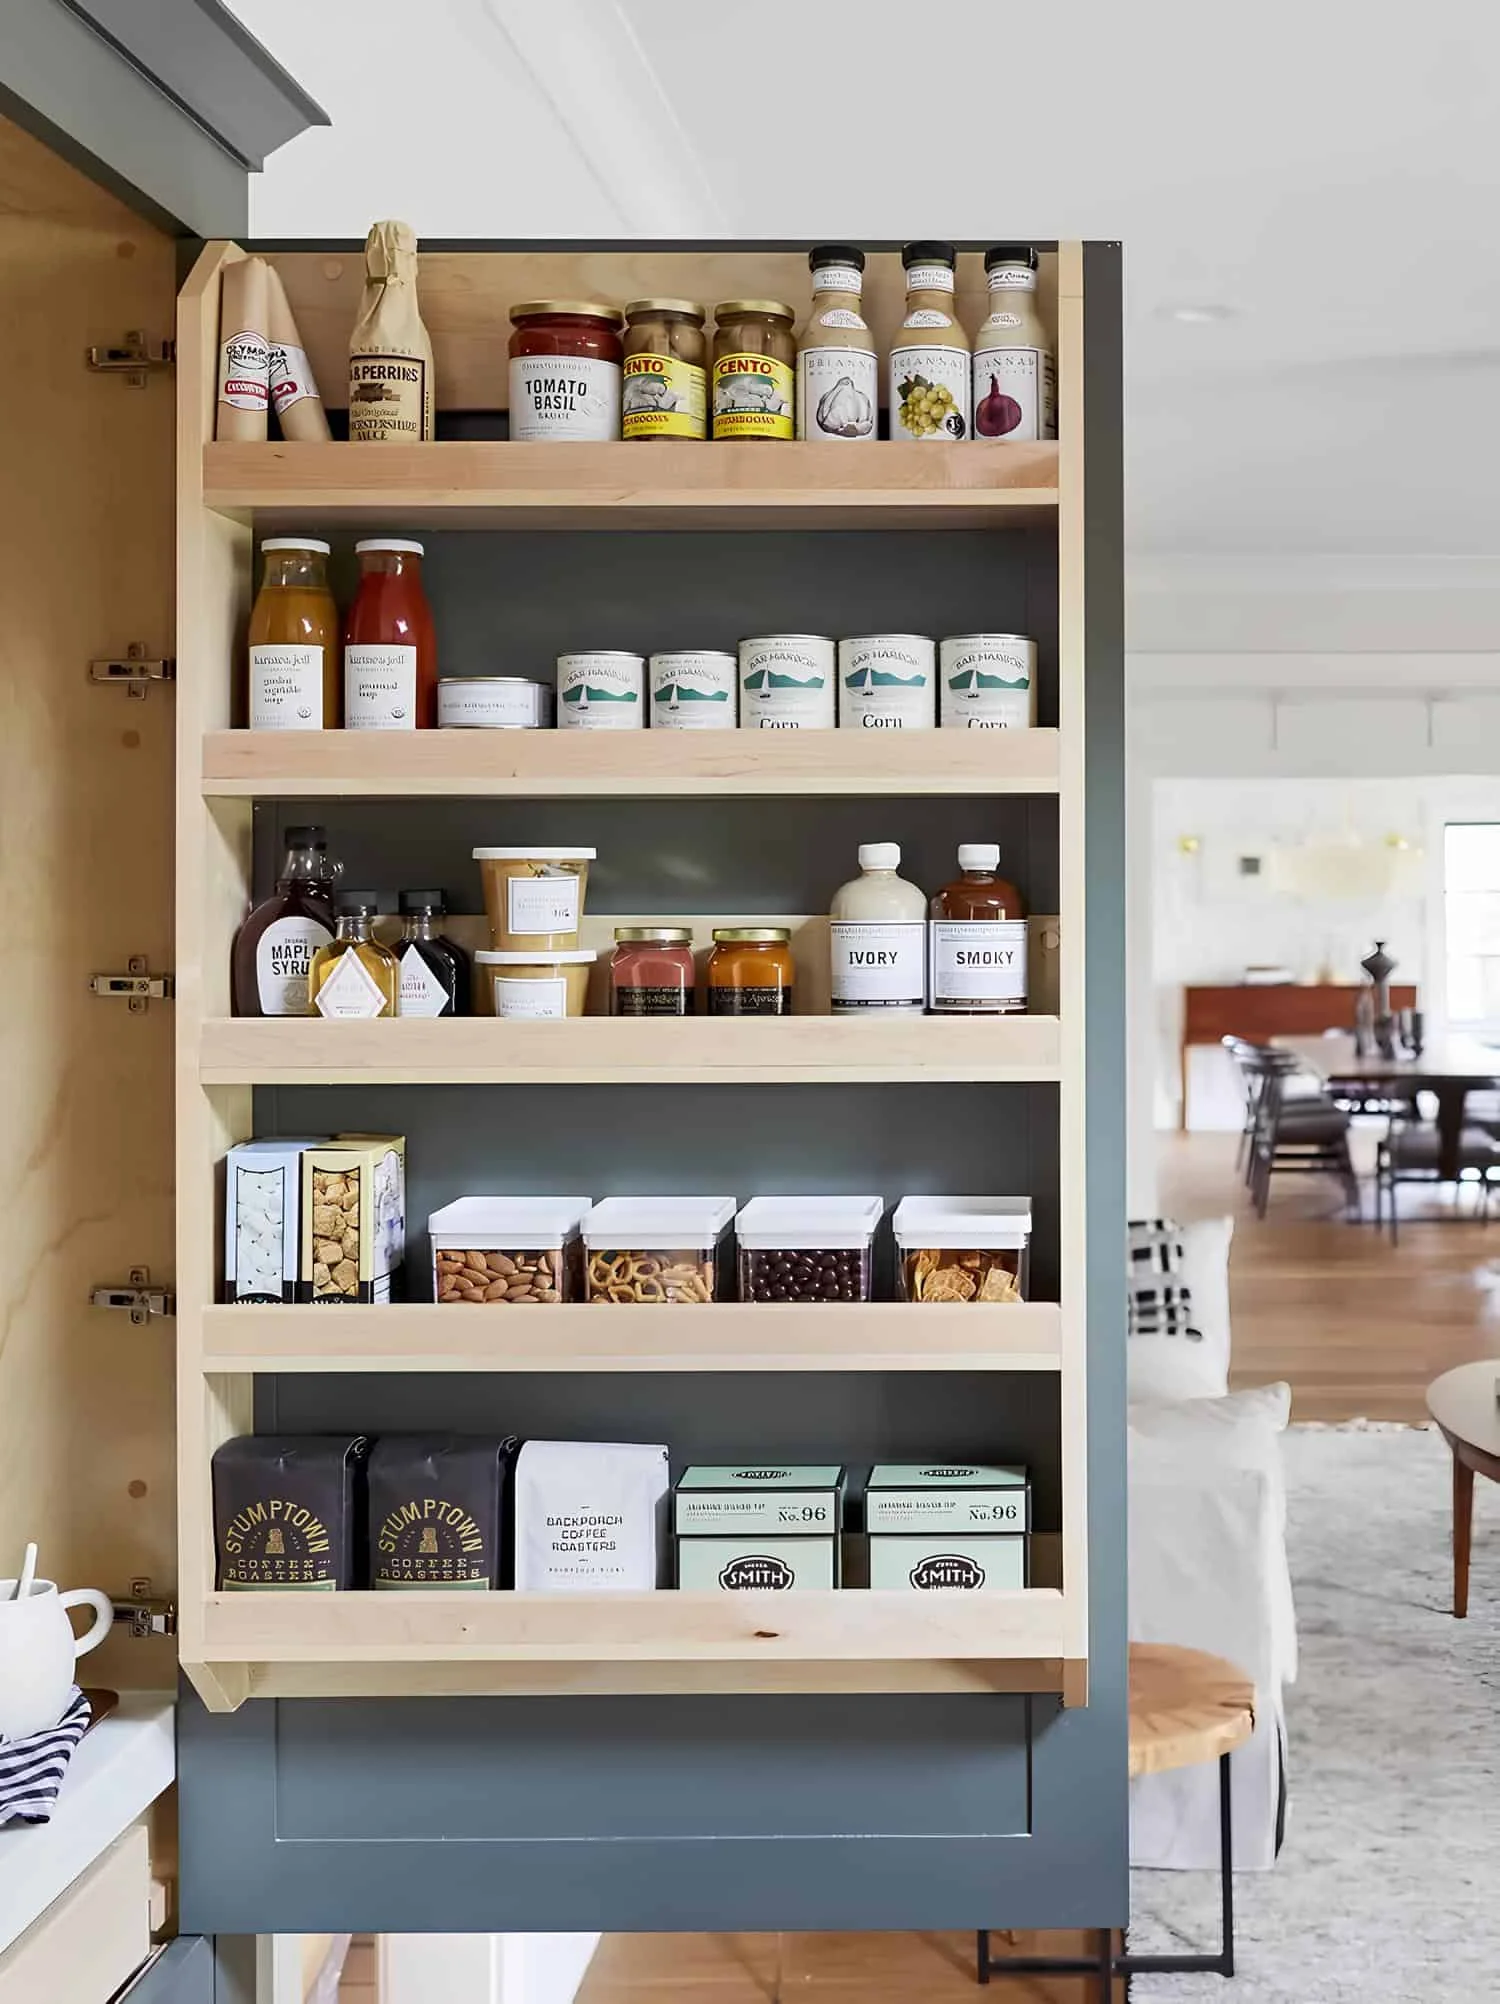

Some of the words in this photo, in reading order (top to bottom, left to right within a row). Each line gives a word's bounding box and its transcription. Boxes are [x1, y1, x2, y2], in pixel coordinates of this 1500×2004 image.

[719, 360, 772, 375] CENTO
[525, 379, 587, 397] TOMATO
[534, 395, 577, 411] BASIL
[862, 714, 902, 728] Corn
[849, 951, 898, 965] IVORY
[956, 951, 1014, 965] SMOKY
[225, 1500, 330, 1554] STUMPTOWN
[379, 1499, 483, 1552] STUMPTOWN
[561, 1528, 607, 1539] COFFEE
[552, 1541, 616, 1551] ROASTERS
[391, 1558, 467, 1568] COFFEE
[380, 1568, 480, 1579] ROASTERS
[730, 1570, 784, 1585] SMITH
[920, 1569, 974, 1584] SMITH
